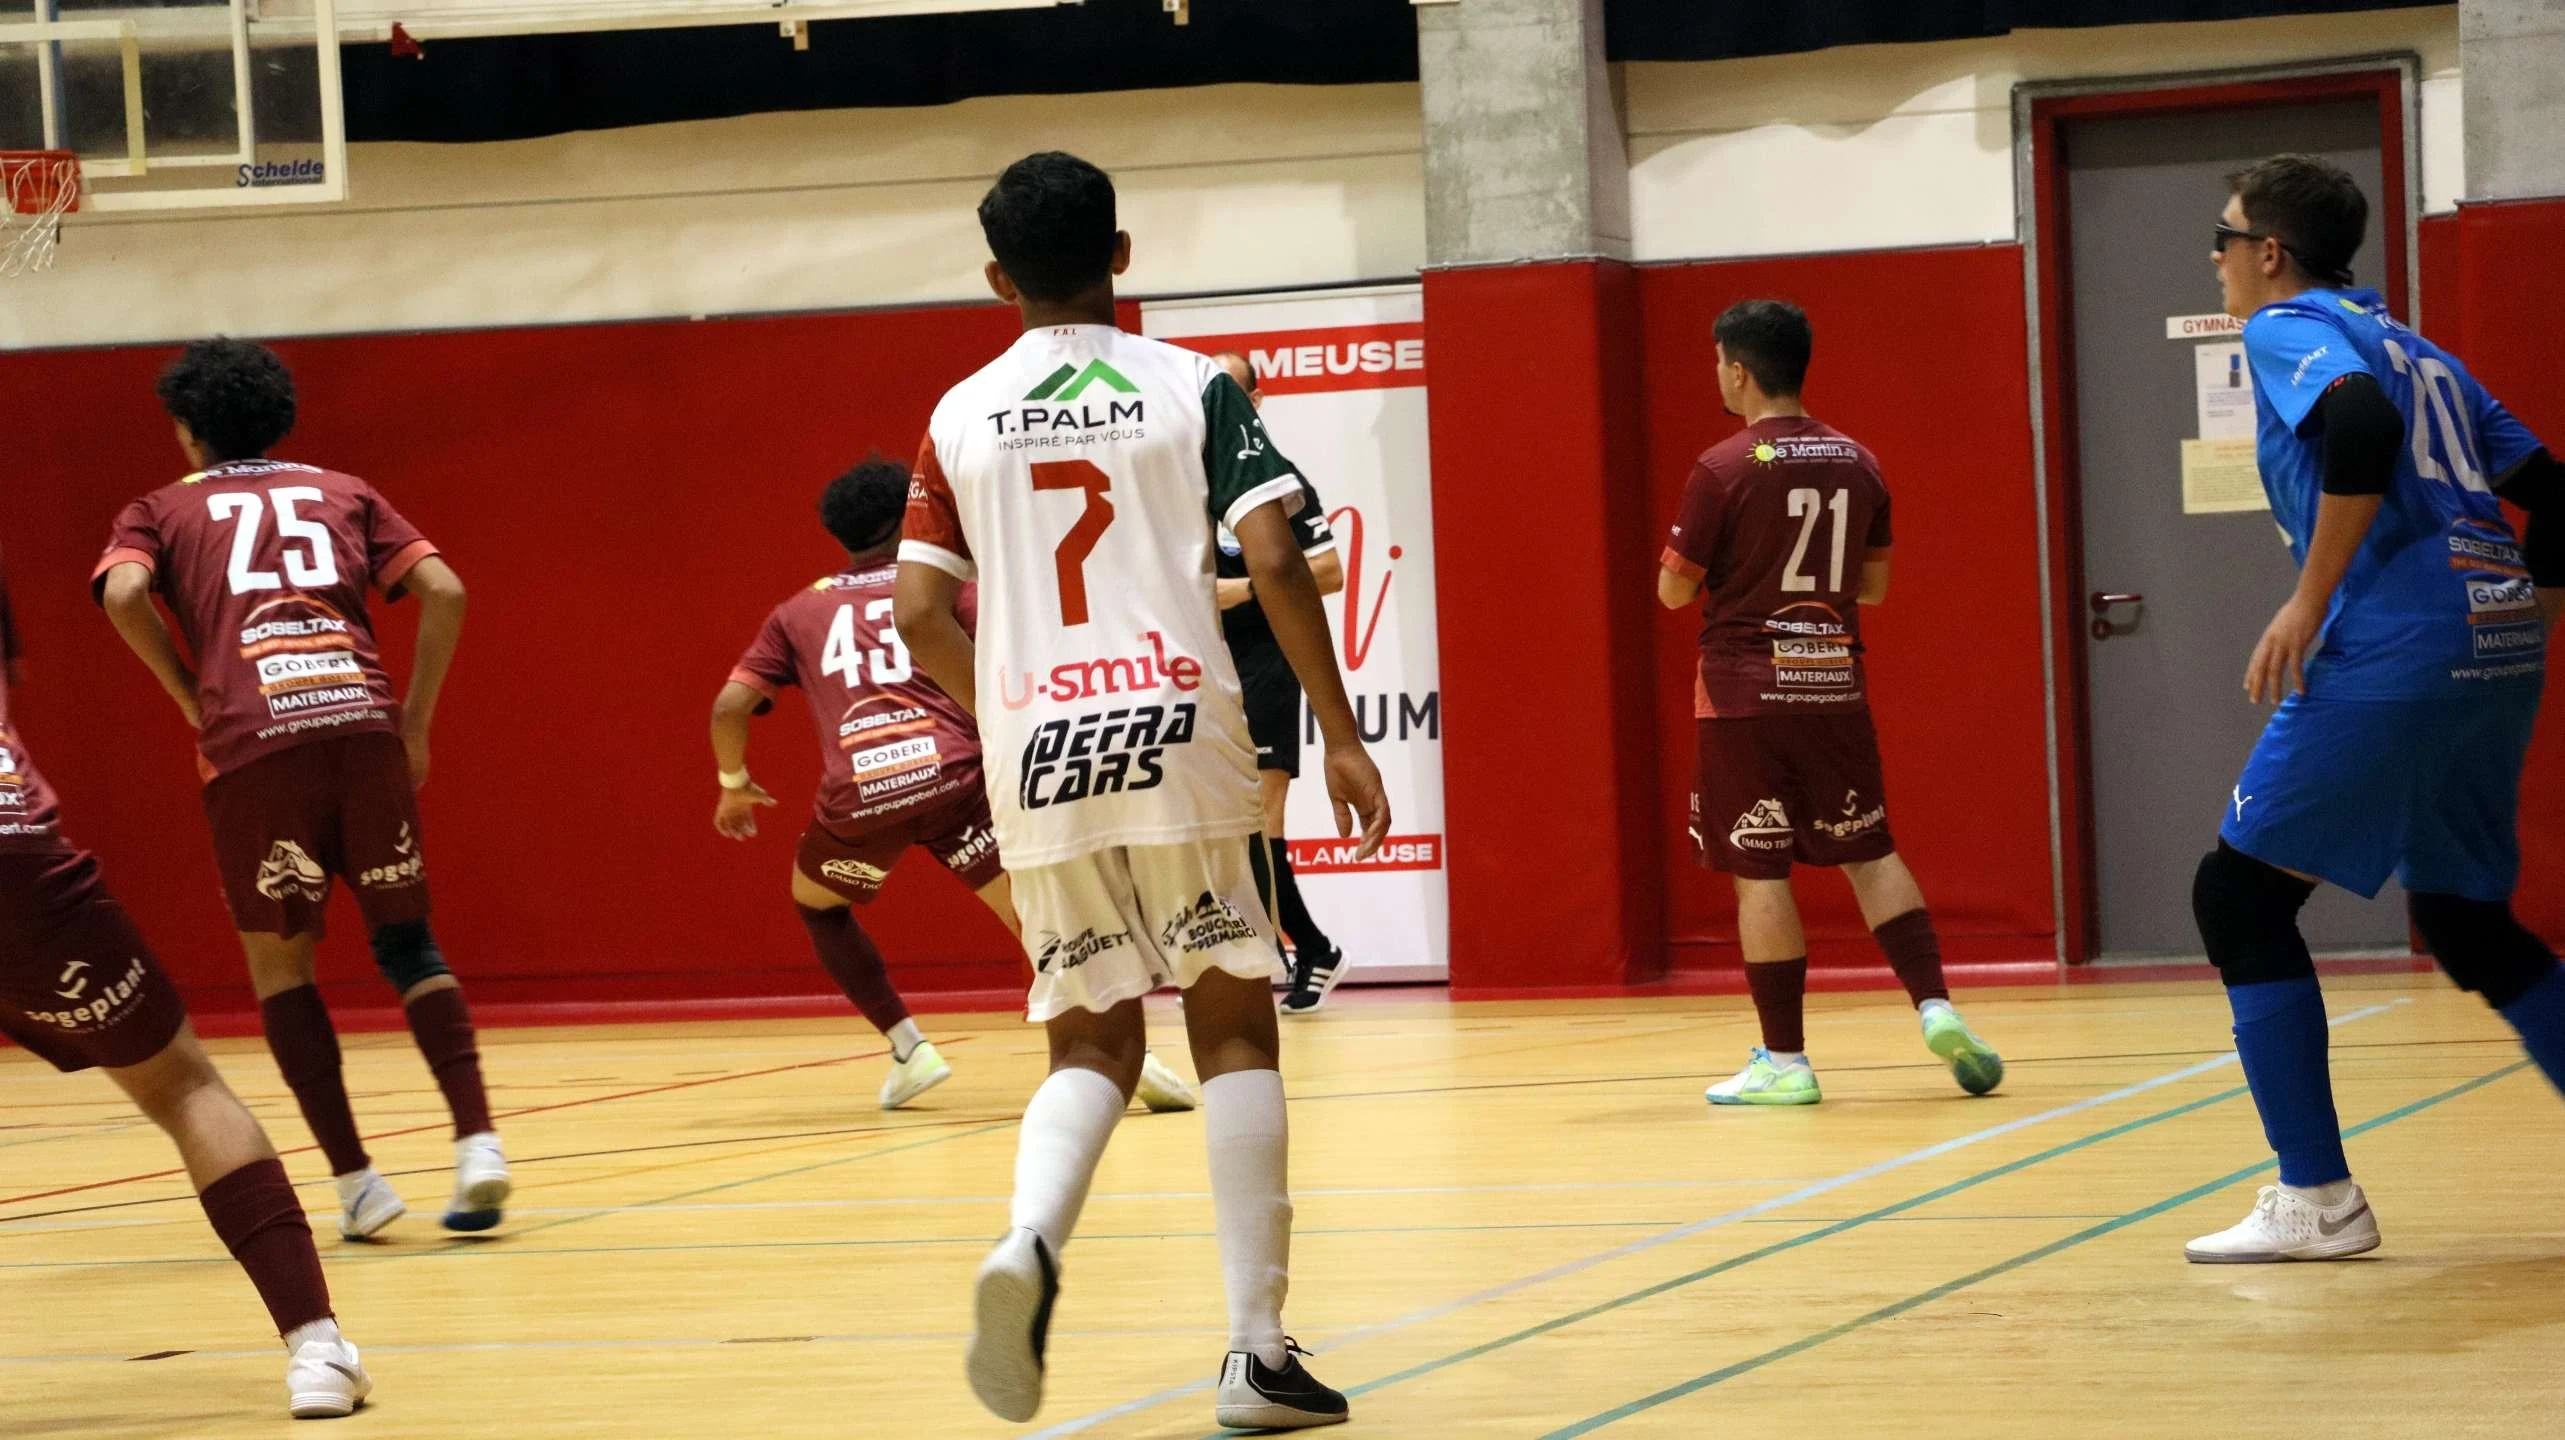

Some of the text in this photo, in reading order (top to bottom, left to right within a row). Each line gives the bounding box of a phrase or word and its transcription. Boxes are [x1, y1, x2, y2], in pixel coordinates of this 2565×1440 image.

[237, 159, 324, 188] Schelde
[1249, 339, 1424, 380] MEUSE
[987, 400, 1144, 435] T.PALM
[2383, 338, 2493, 495] 20
[1064, 434, 1096, 446] PAR
[1100, 427, 1145, 442] VOUS
[207, 486, 338, 595] 25
[1030, 459, 1116, 626] 7
[1781, 488, 1849, 593] 21
[240, 617, 347, 645] SOBELTAX
[820, 598, 912, 688] 43
[264, 656, 350, 677] GOBERT
[1780, 670, 1851, 682] MATERIAUX
[271, 686, 366, 712] MATERIAUX
[840, 707, 927, 736] SOBELTAX
[1034, 702, 1197, 765] DEFRA
[857, 741, 930, 767] GOBERT
[862, 766, 937, 796] MATERIAUX
[1027, 747, 1164, 809] CARS
[1741, 836, 1772, 850] IMMO
